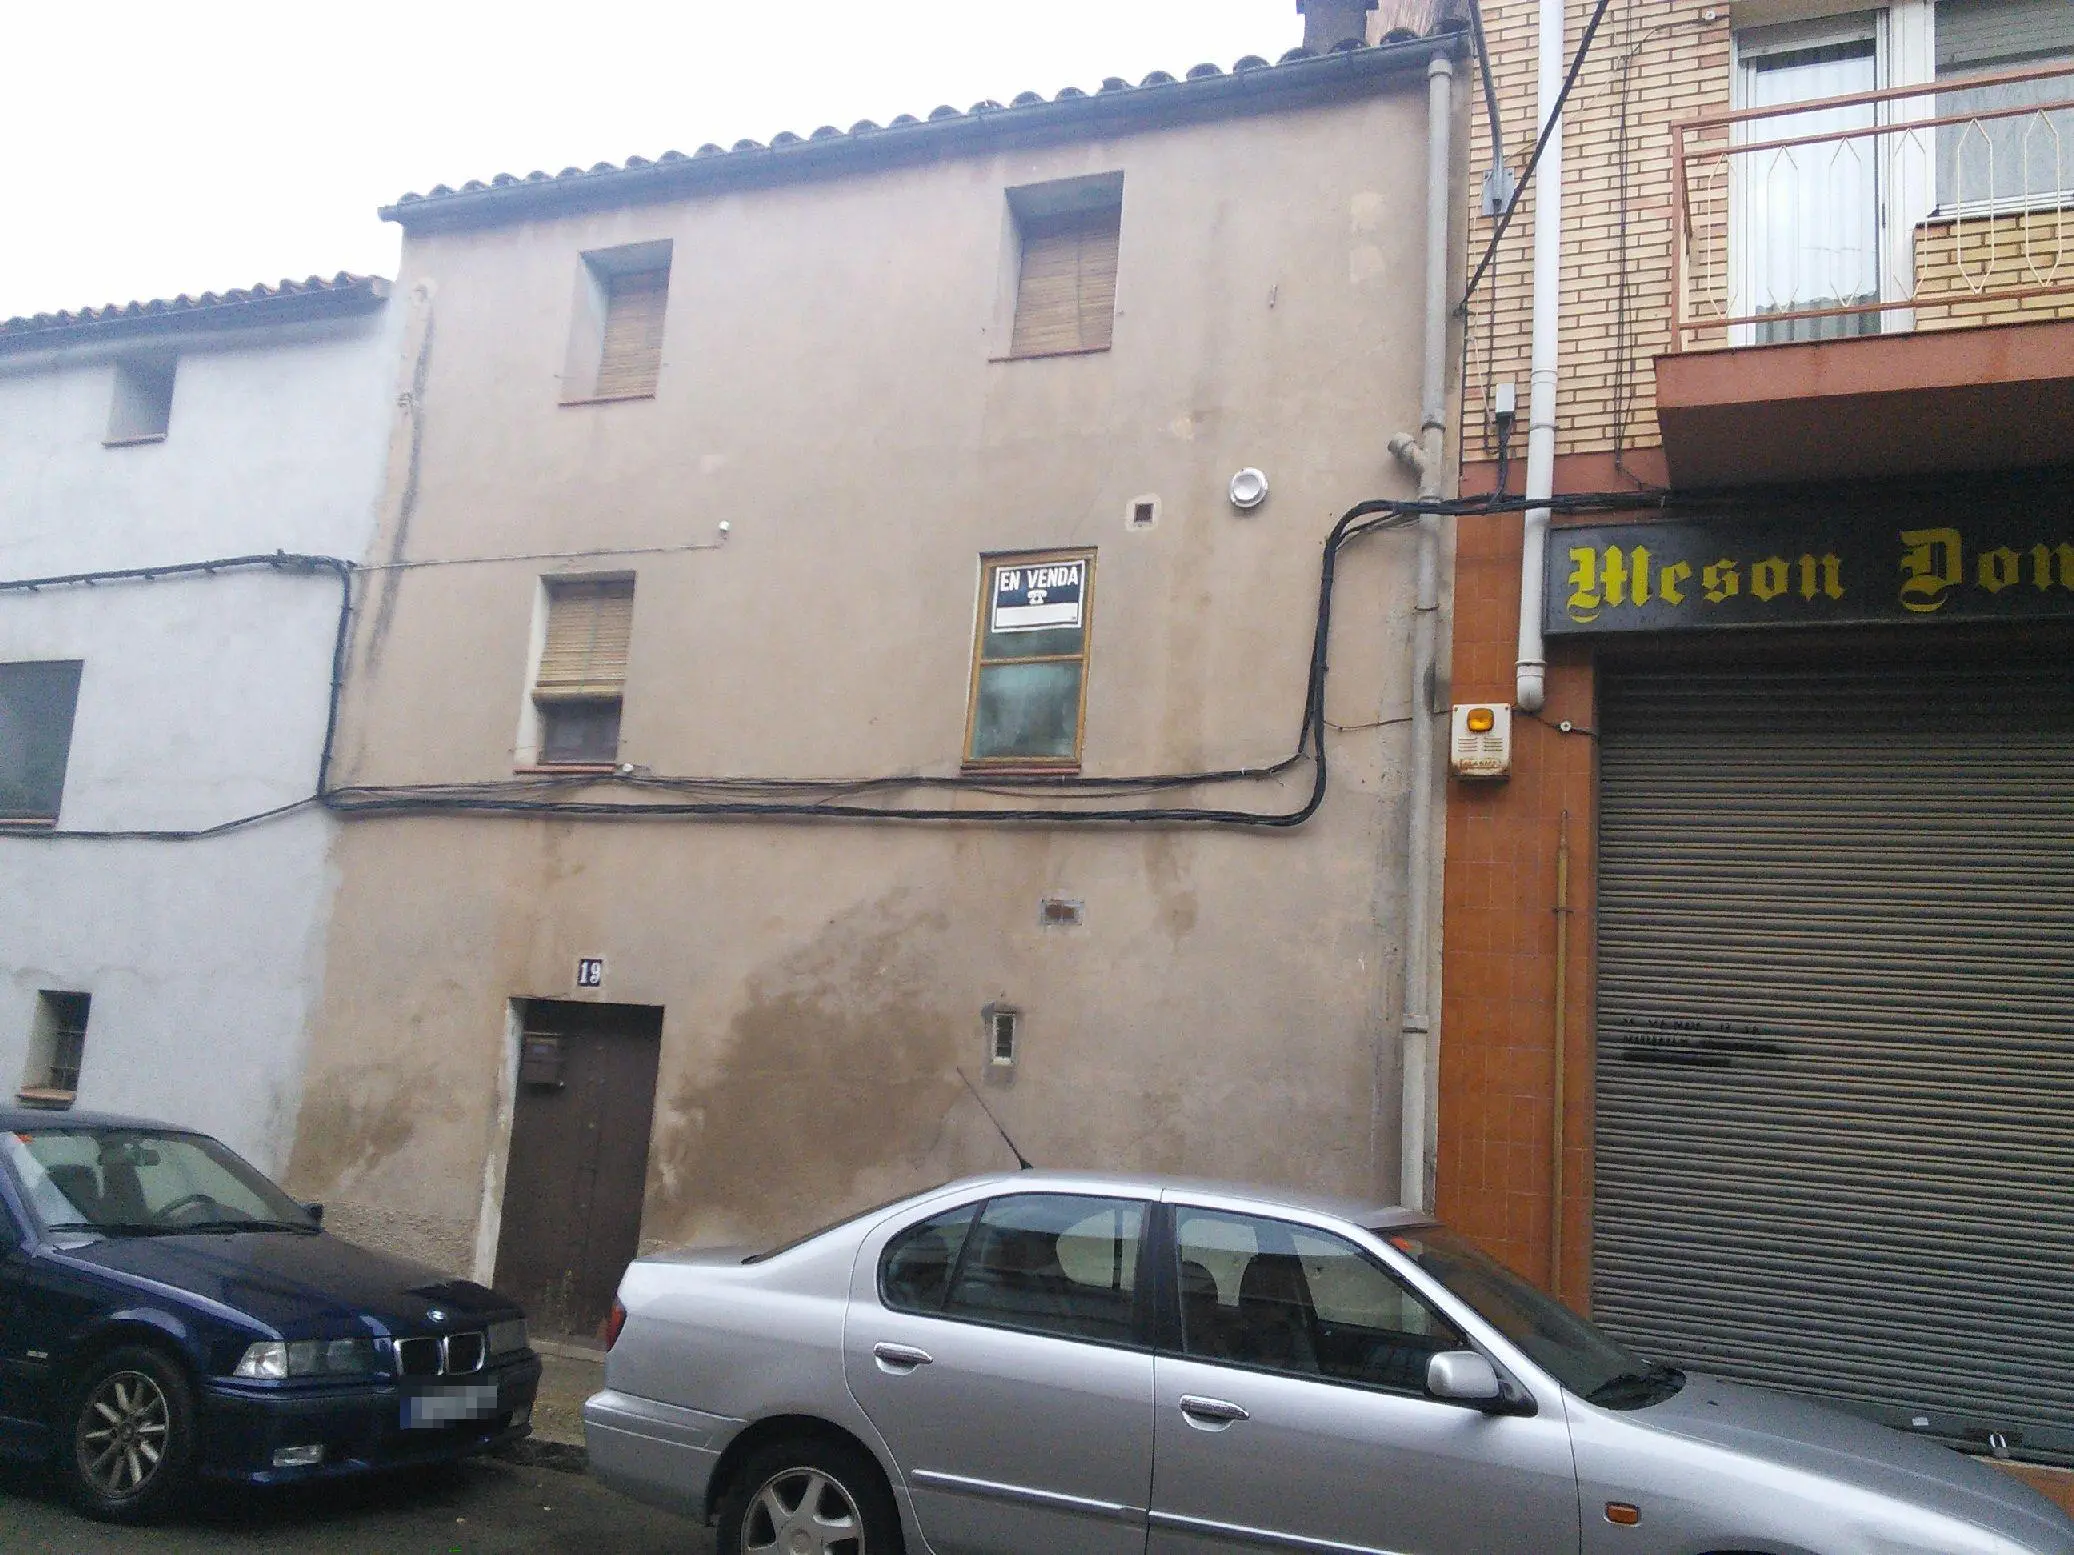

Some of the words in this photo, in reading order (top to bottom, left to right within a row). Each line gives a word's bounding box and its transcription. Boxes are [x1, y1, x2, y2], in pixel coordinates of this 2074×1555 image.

[1000, 570, 1020, 592] EN
[1027, 566, 1079, 589] VENDA
[1566, 543, 1846, 624] Meson
[580, 962, 601, 984] 19
